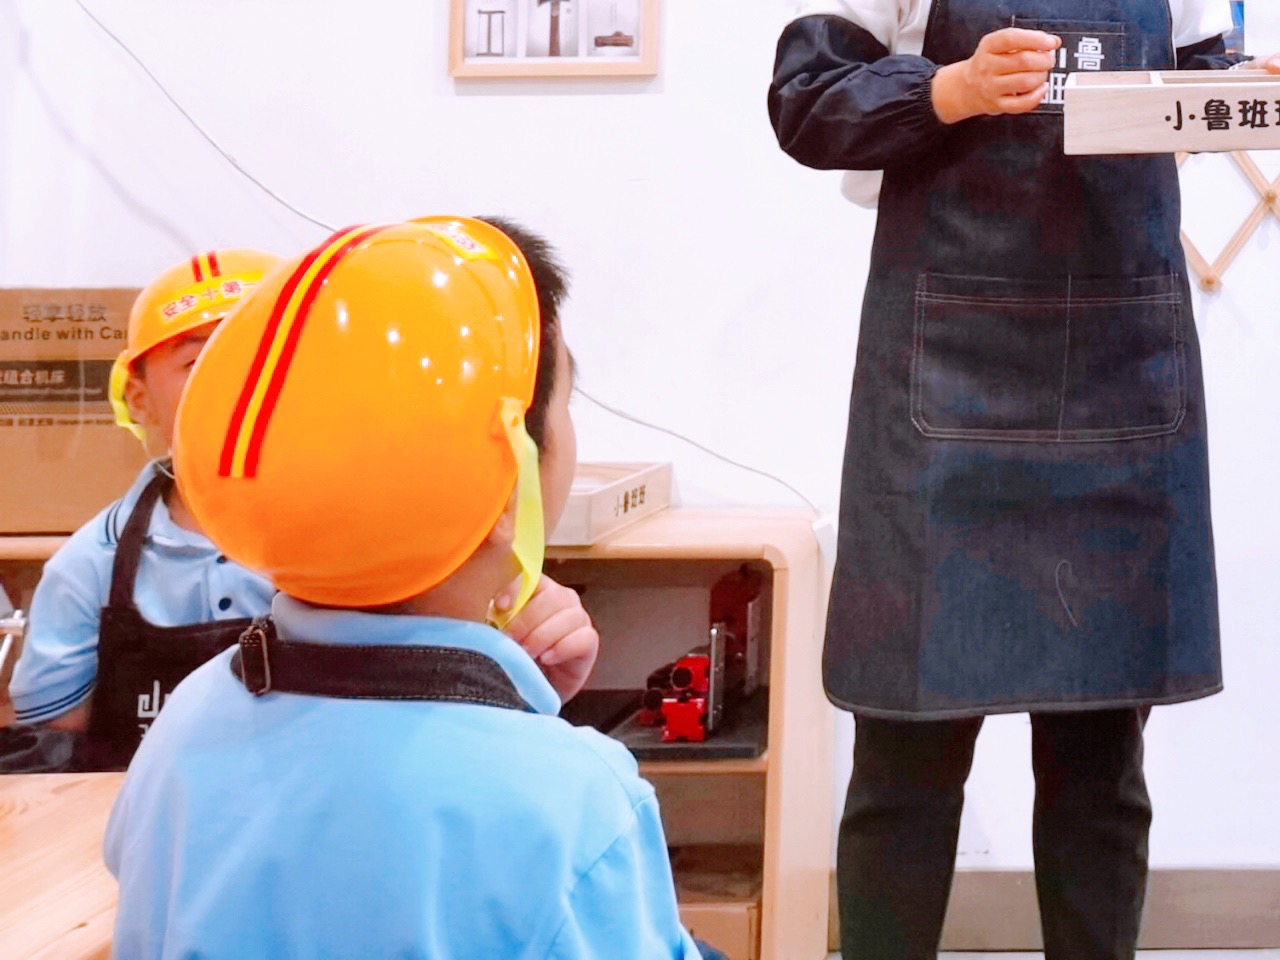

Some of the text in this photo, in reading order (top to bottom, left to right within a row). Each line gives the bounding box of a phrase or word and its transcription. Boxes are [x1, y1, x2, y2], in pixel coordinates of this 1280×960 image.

[57, 327, 94, 340] with
[0, 369, 65, 385] 组合机床
